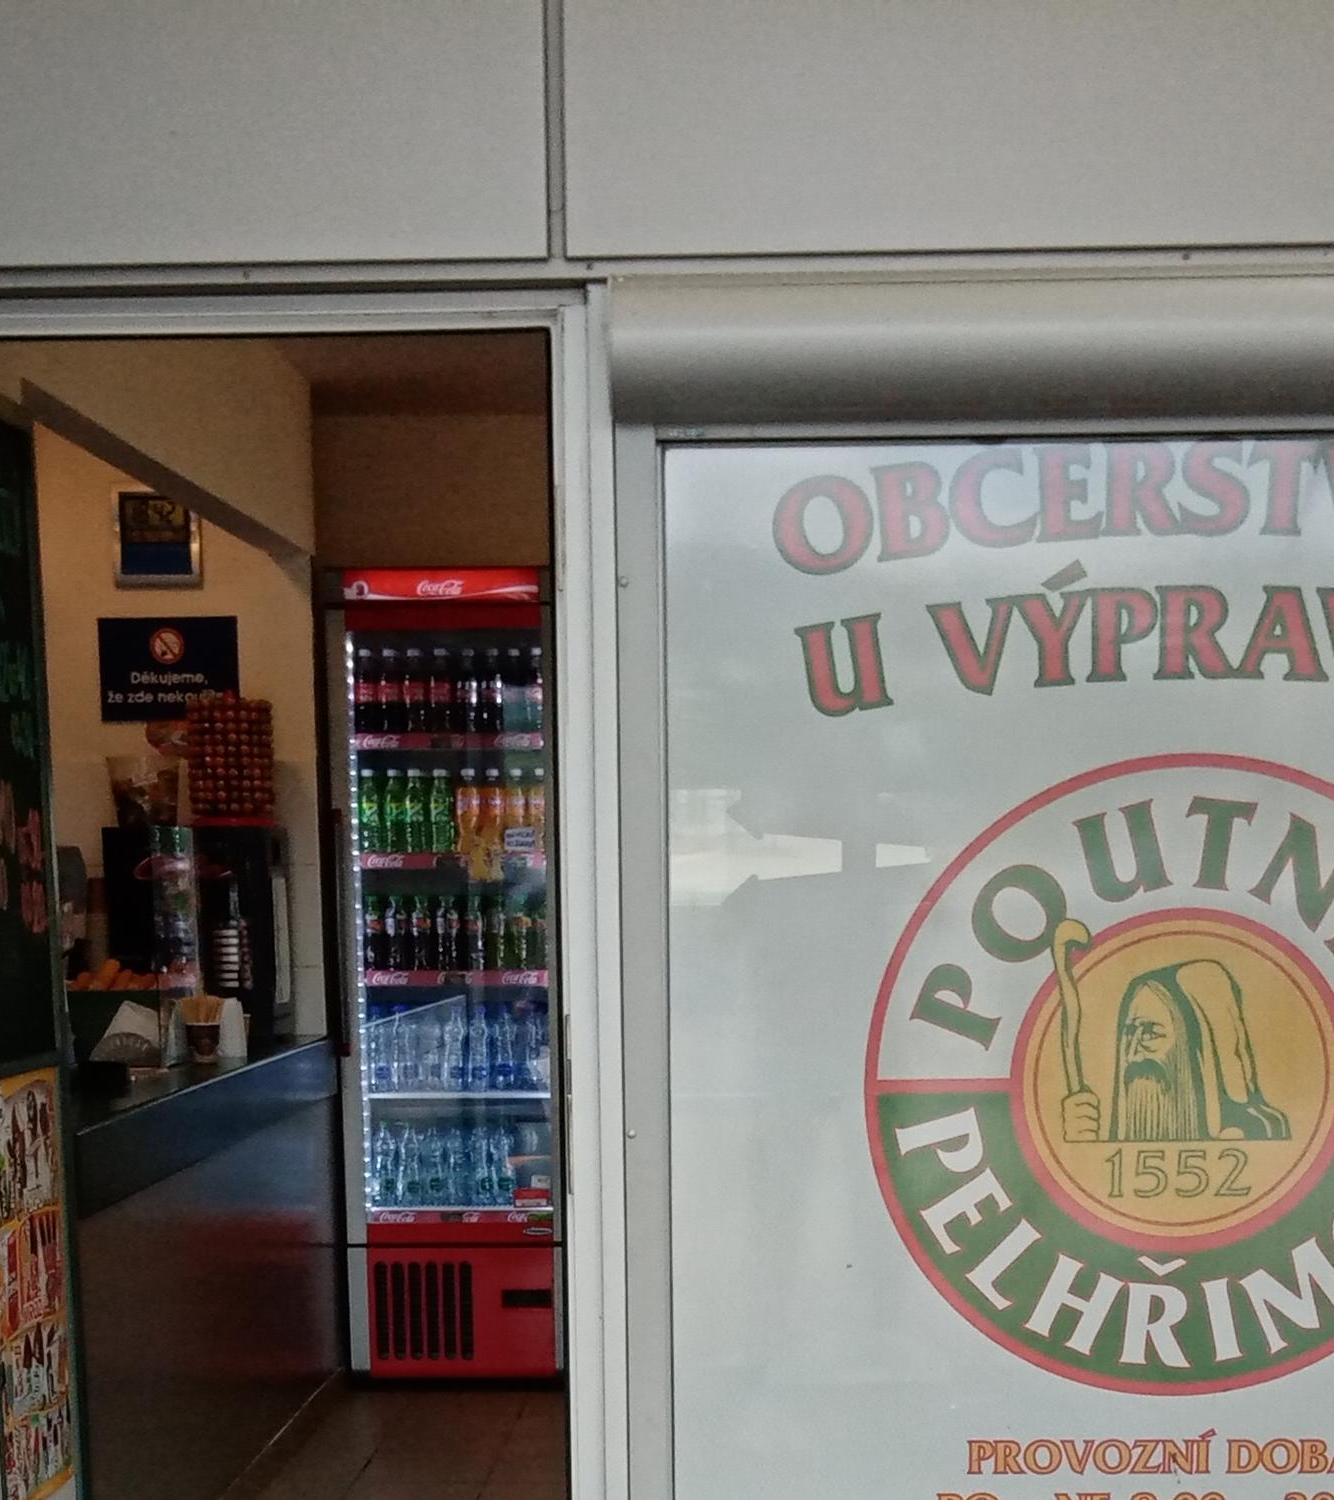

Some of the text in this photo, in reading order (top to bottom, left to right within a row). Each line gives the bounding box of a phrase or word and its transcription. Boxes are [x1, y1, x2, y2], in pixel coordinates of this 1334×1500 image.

[129, 671, 208, 687] Děkujeme,
[794, 612, 894, 718] U
[127, 689, 154, 704] zde
[1103, 1146, 1253, 1200] 1552
[966, 1428, 1217, 1475] PROVOZNÍ
